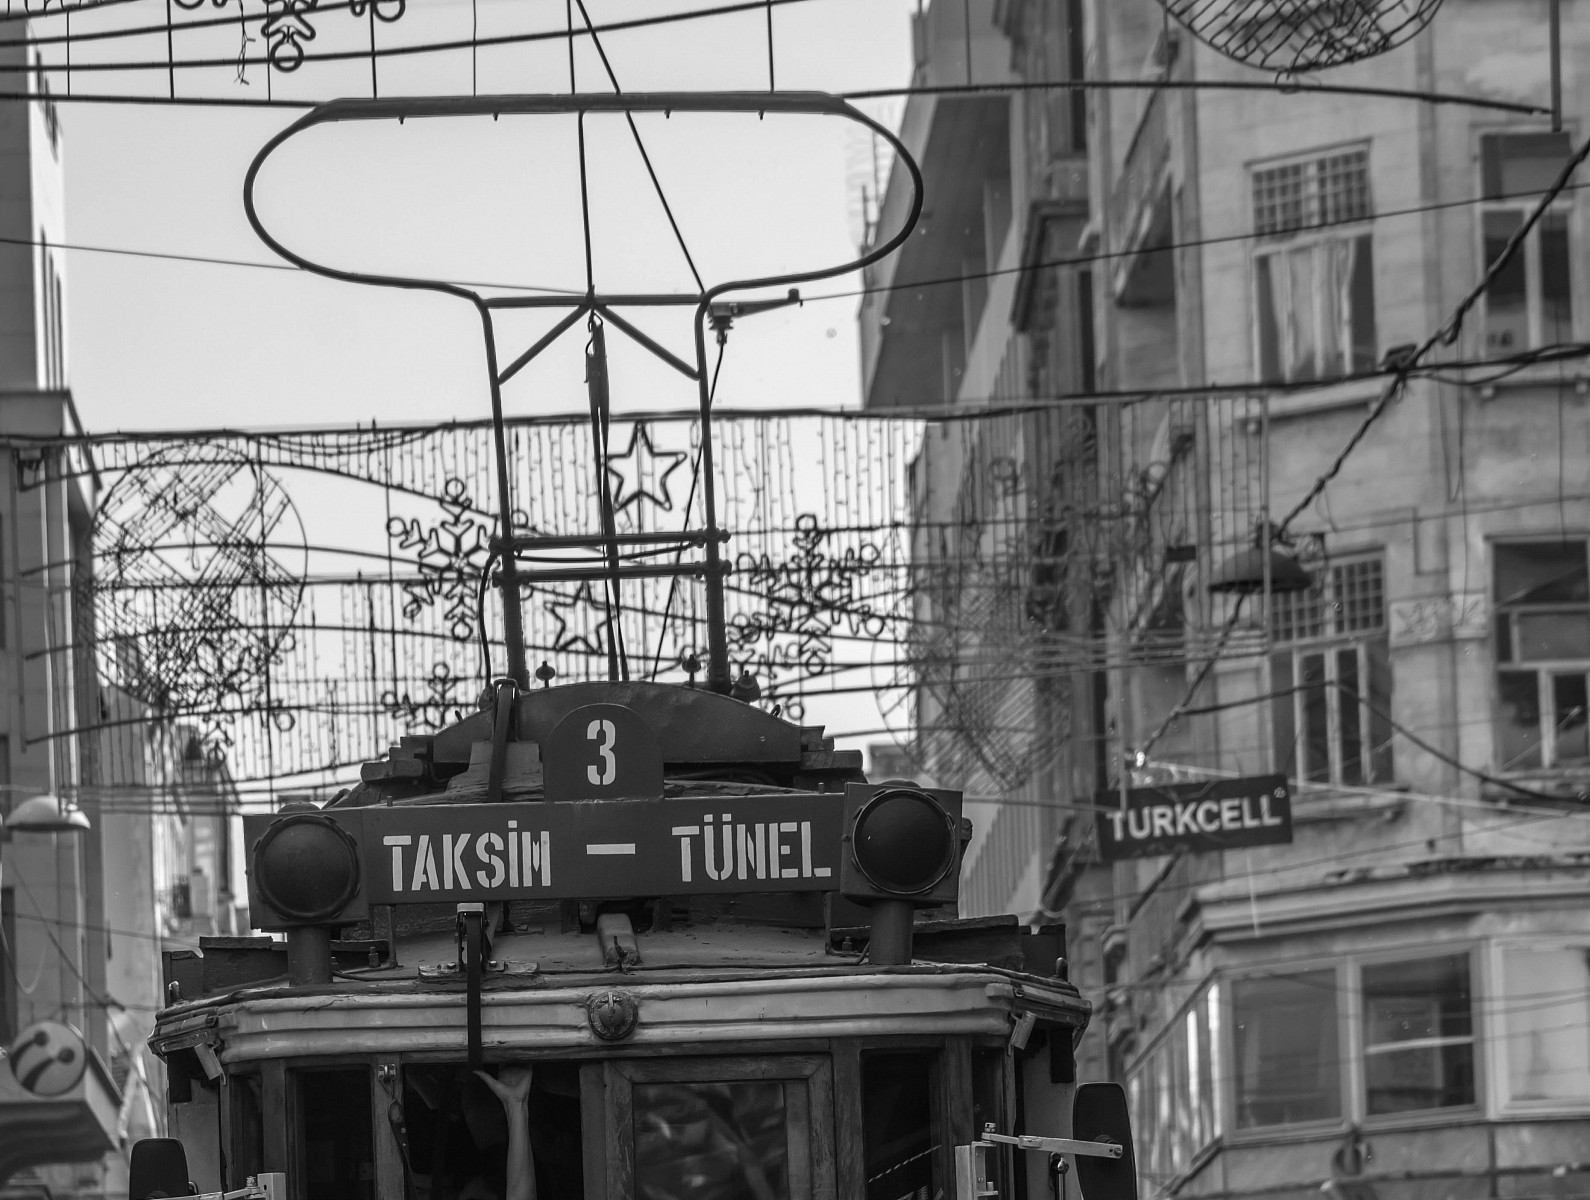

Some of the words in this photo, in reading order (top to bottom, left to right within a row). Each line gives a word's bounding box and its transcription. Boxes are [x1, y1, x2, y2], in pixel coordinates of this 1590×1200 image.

[586, 719, 617, 786] 3
[1105, 794, 1284, 842] TURKCELL
[383, 819, 552, 892] TAKSİM
[671, 813, 832, 883] TÜNEL
